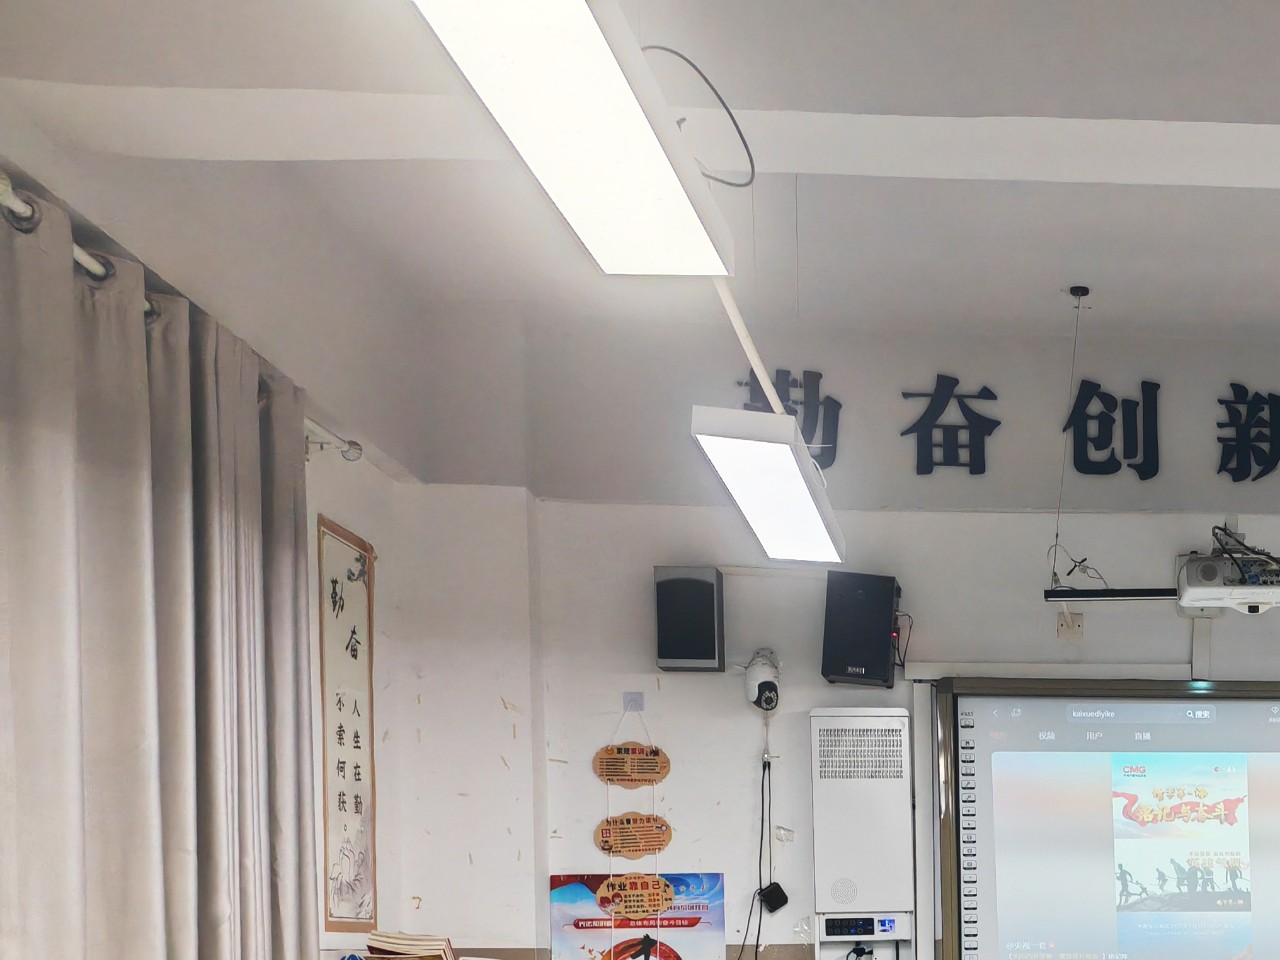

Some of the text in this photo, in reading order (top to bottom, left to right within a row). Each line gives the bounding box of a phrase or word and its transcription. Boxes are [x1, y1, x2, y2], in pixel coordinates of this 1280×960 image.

[329, 577, 362, 661] 勤奋
[1072, 710, 1115, 719] kaixuediyike
[1195, 710, 1210, 719] 搜索
[1039, 731, 1055, 740] 视频
[1086, 731, 1103, 740] 用户
[1135, 731, 1151, 741] 直播
[351, 699, 363, 817] 人生在勤
[1123, 766, 1146, 774] CMG
[606, 881, 661, 892] 作业靠自己
